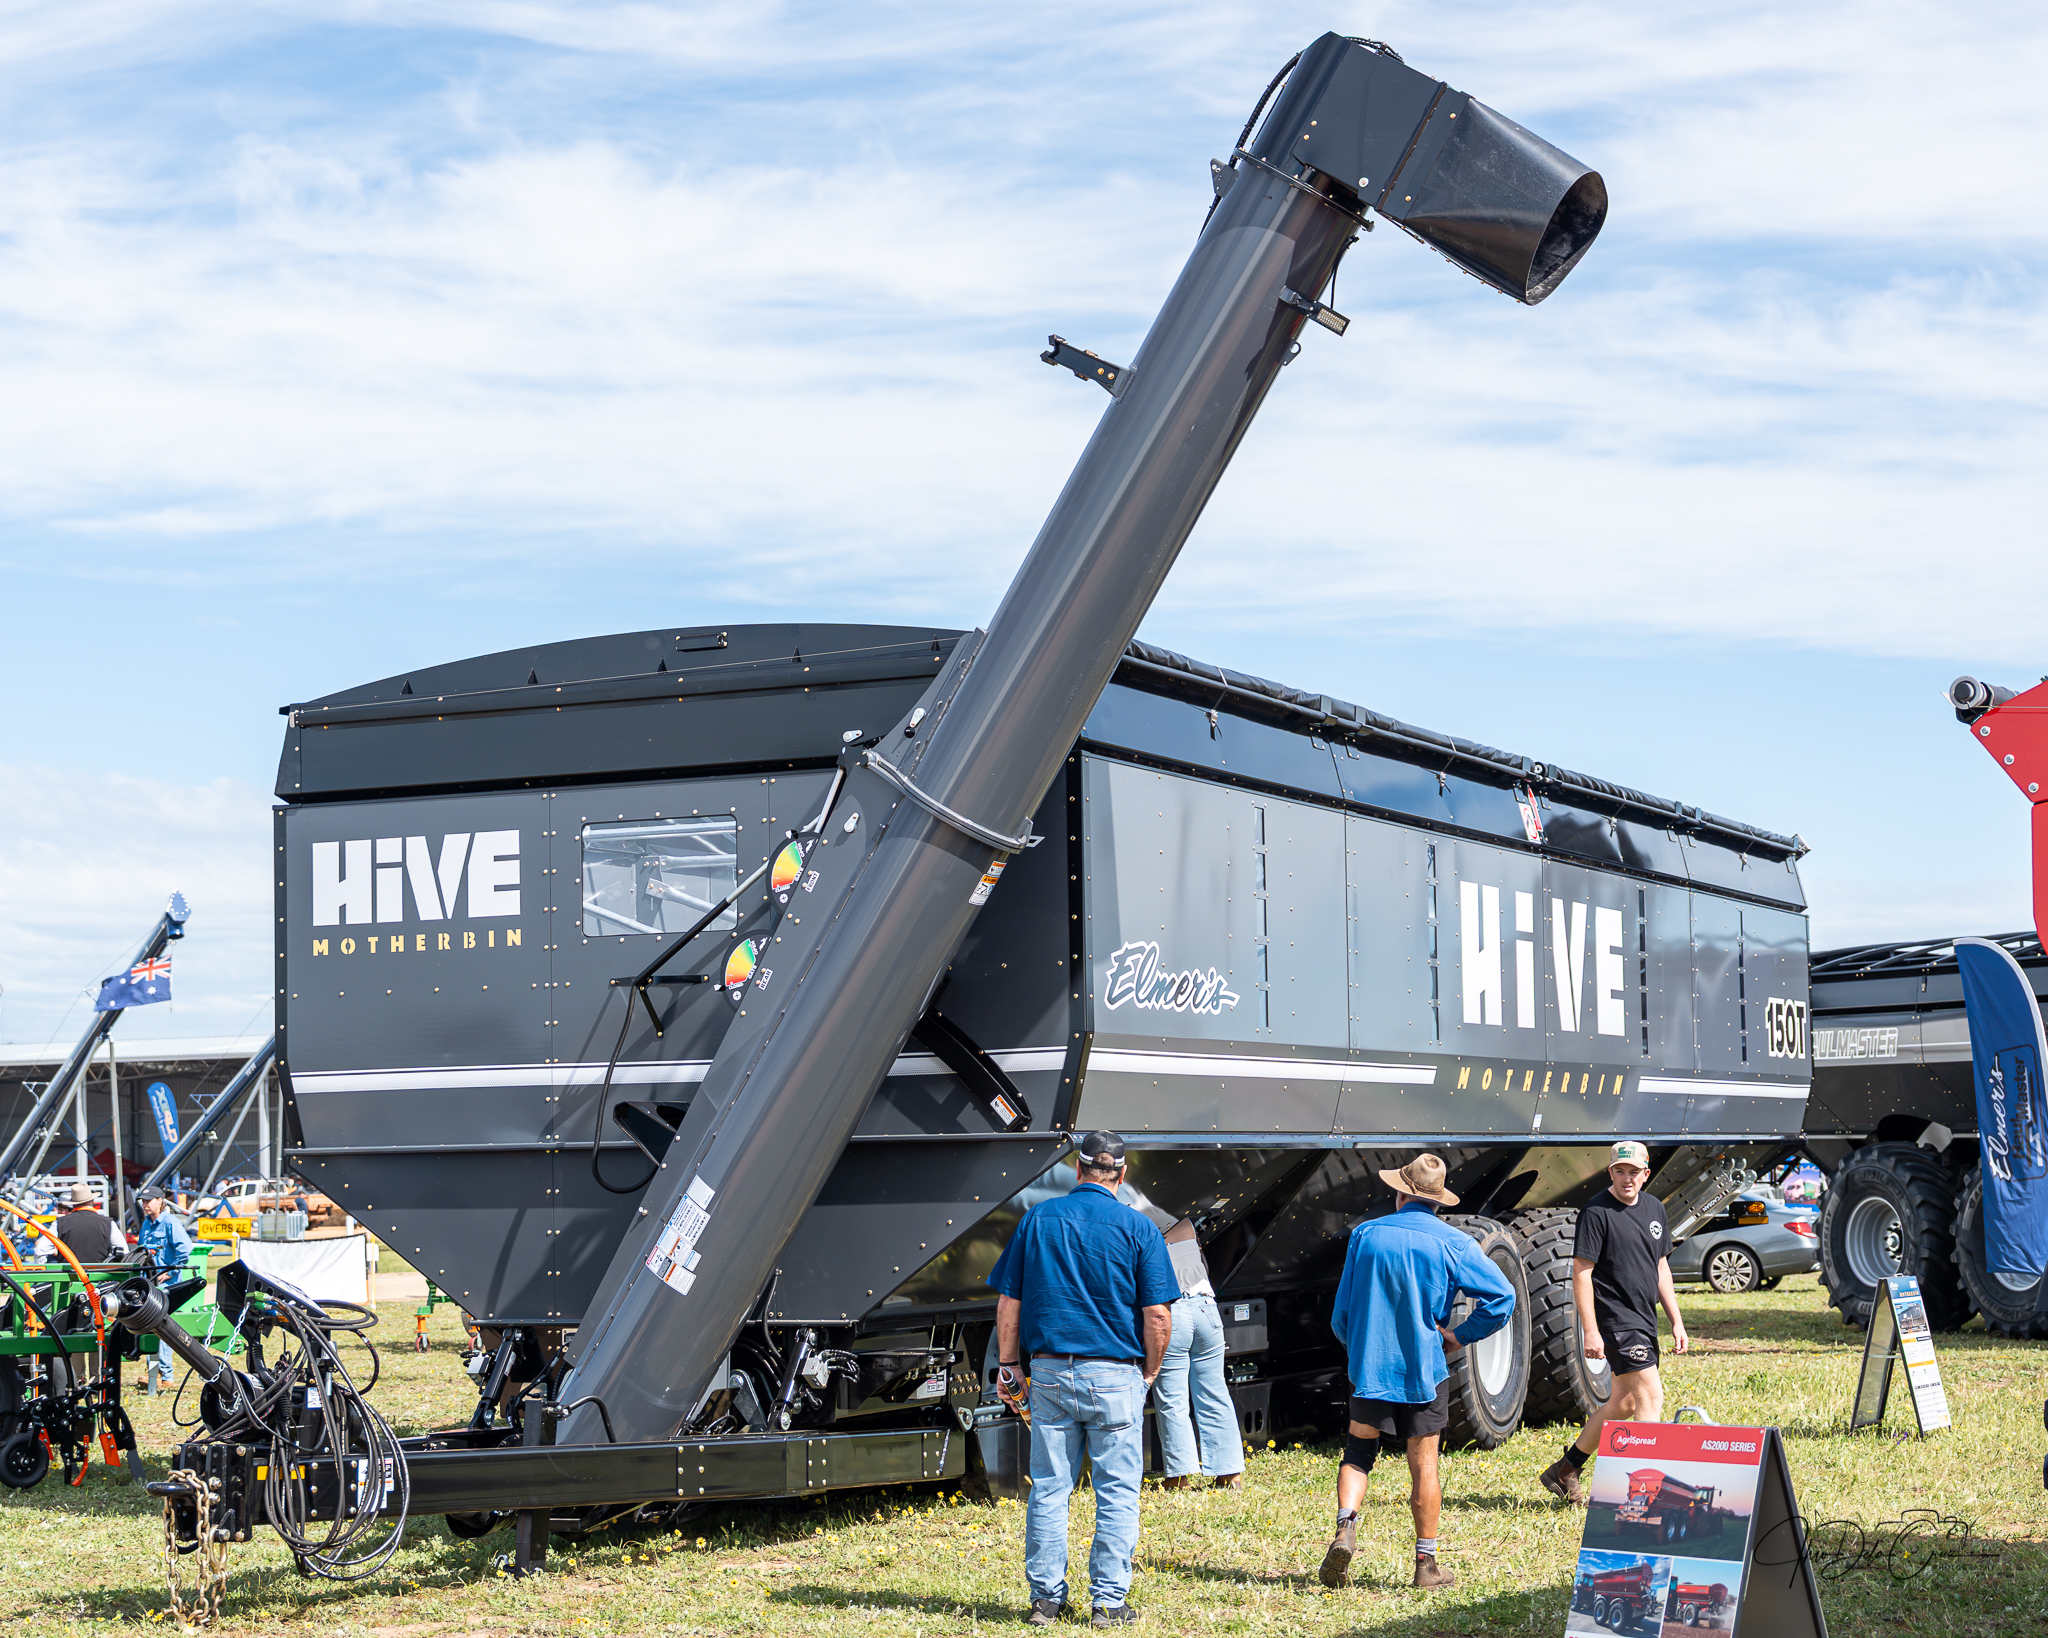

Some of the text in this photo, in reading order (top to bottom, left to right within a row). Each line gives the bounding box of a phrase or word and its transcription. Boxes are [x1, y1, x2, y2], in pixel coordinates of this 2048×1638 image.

[806, 872, 818, 891] FRONT
[312, 929, 522, 957] MOTHERBIN
[761, 970, 771, 988] REAR
[1104, 940, 1241, 1015] Elmer's
[1765, 997, 1806, 1059] 150T
[1813, 1027, 1899, 1060] AULMASTER
[1457, 1067, 1624, 1095] MOTHERBIN
[1988, 1051, 2012, 1182] Elmer's
[2010, 1056, 2028, 1159] HaulMaster
[202, 1223, 248, 1234] OVERSZE
[1616, 1436, 1656, 1446] AgriSpread
[1701, 1440, 1756, 1453] AS2000 SERIES
